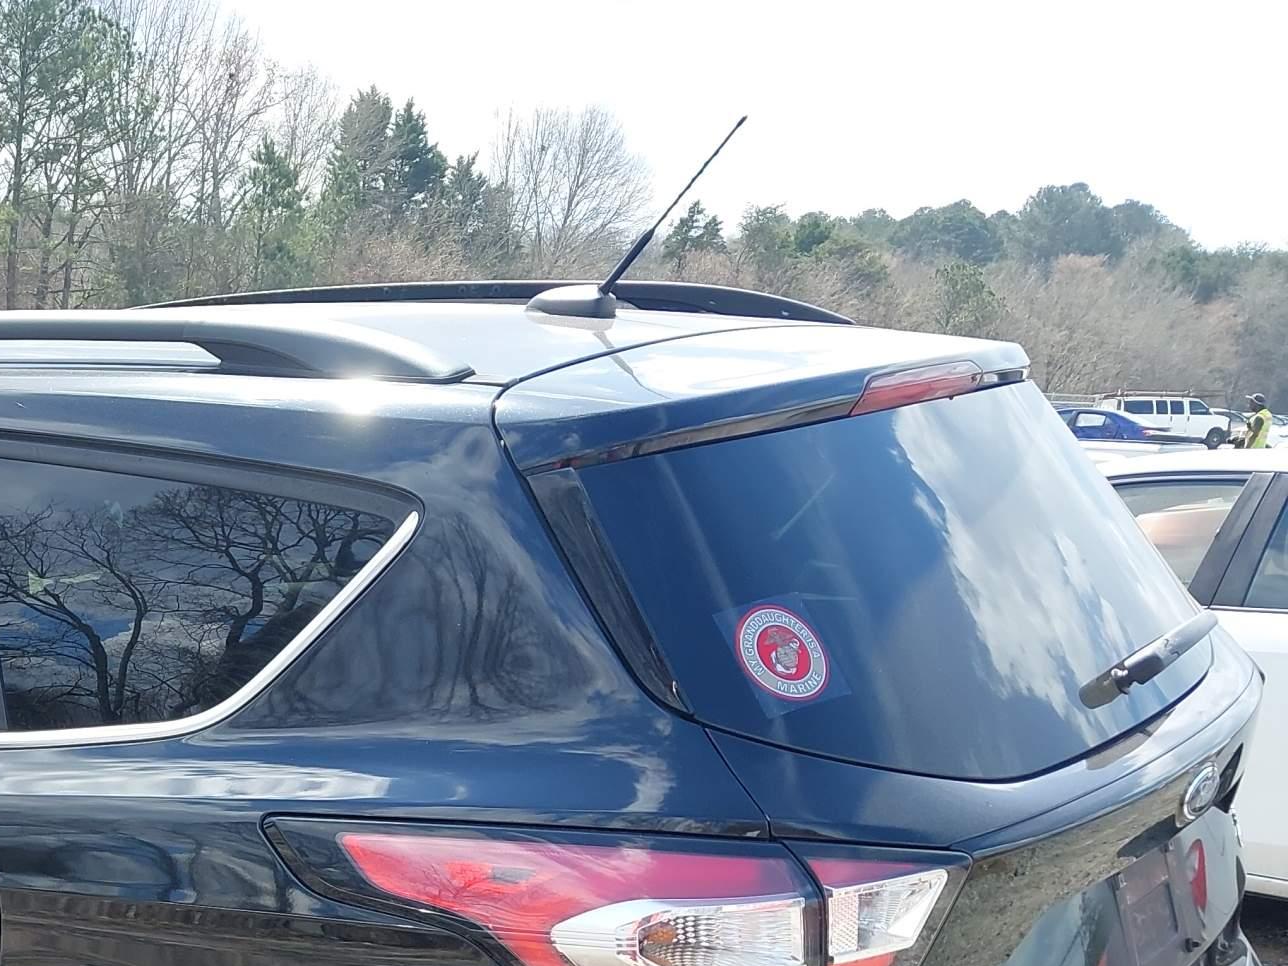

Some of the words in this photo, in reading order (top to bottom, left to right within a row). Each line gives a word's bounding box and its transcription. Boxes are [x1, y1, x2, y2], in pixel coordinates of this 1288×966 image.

[744, 613, 808, 656] GRANDDAUGHTER
[806, 638, 817, 649] IS
[748, 660, 765, 676] MY
[777, 671, 822, 693] MARINE
